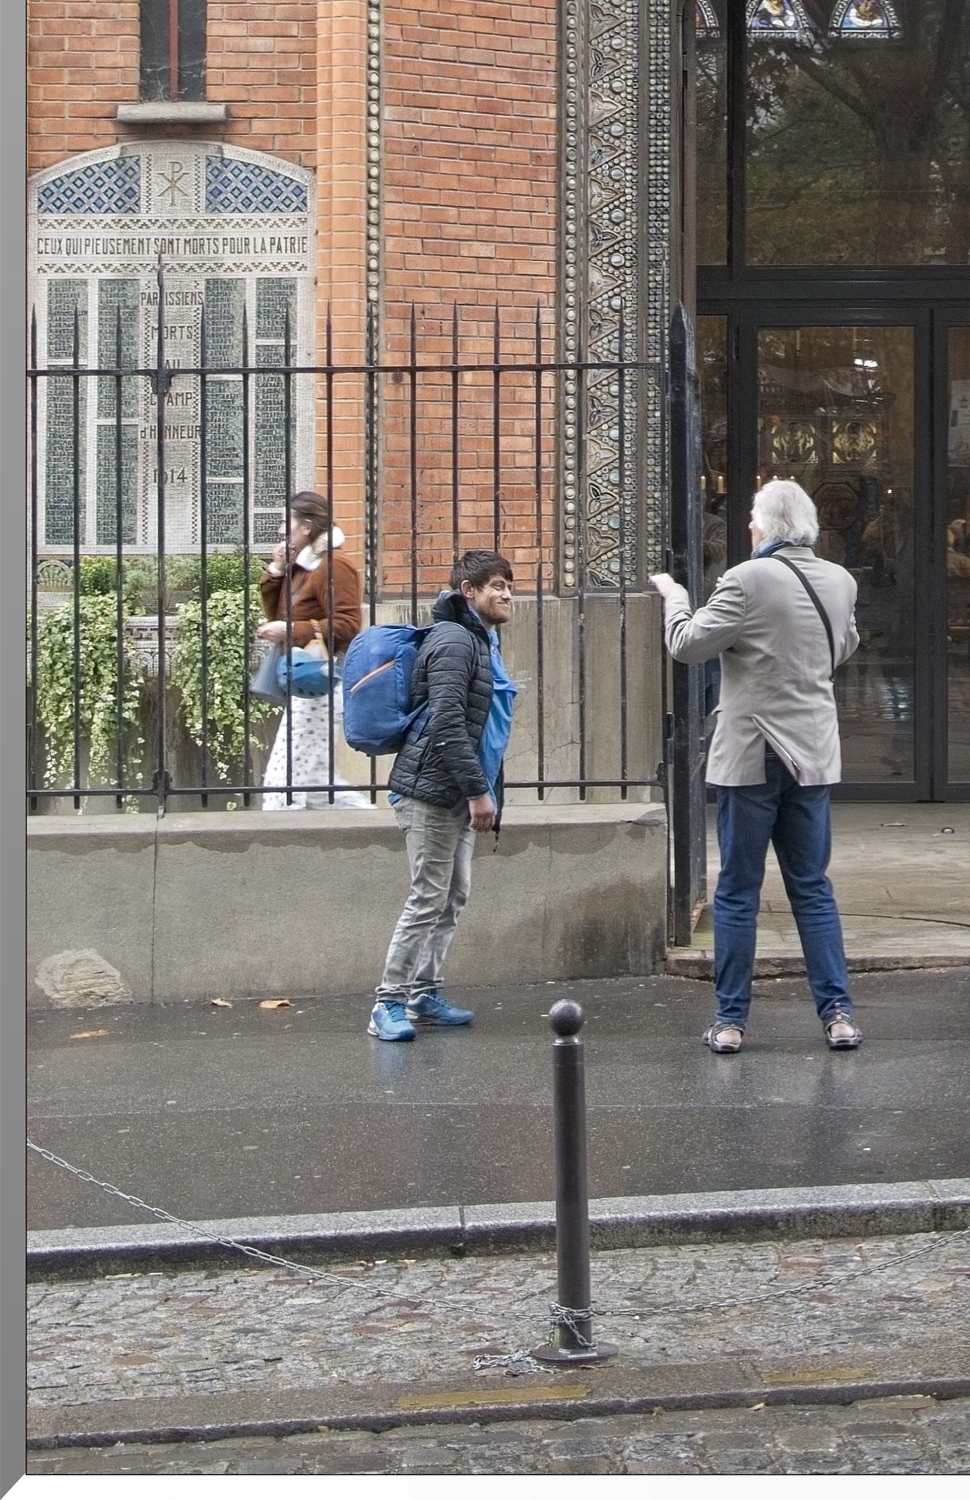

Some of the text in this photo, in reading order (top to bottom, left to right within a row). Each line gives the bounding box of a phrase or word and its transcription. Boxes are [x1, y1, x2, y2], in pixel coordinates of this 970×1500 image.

[37, 236, 308, 256] CEUX QUI PIEUSEMENT SONT MORTS POUR LA PATRIE
[140, 291, 204, 306] PARISSIENS
[150, 392, 193, 406] CAMP
